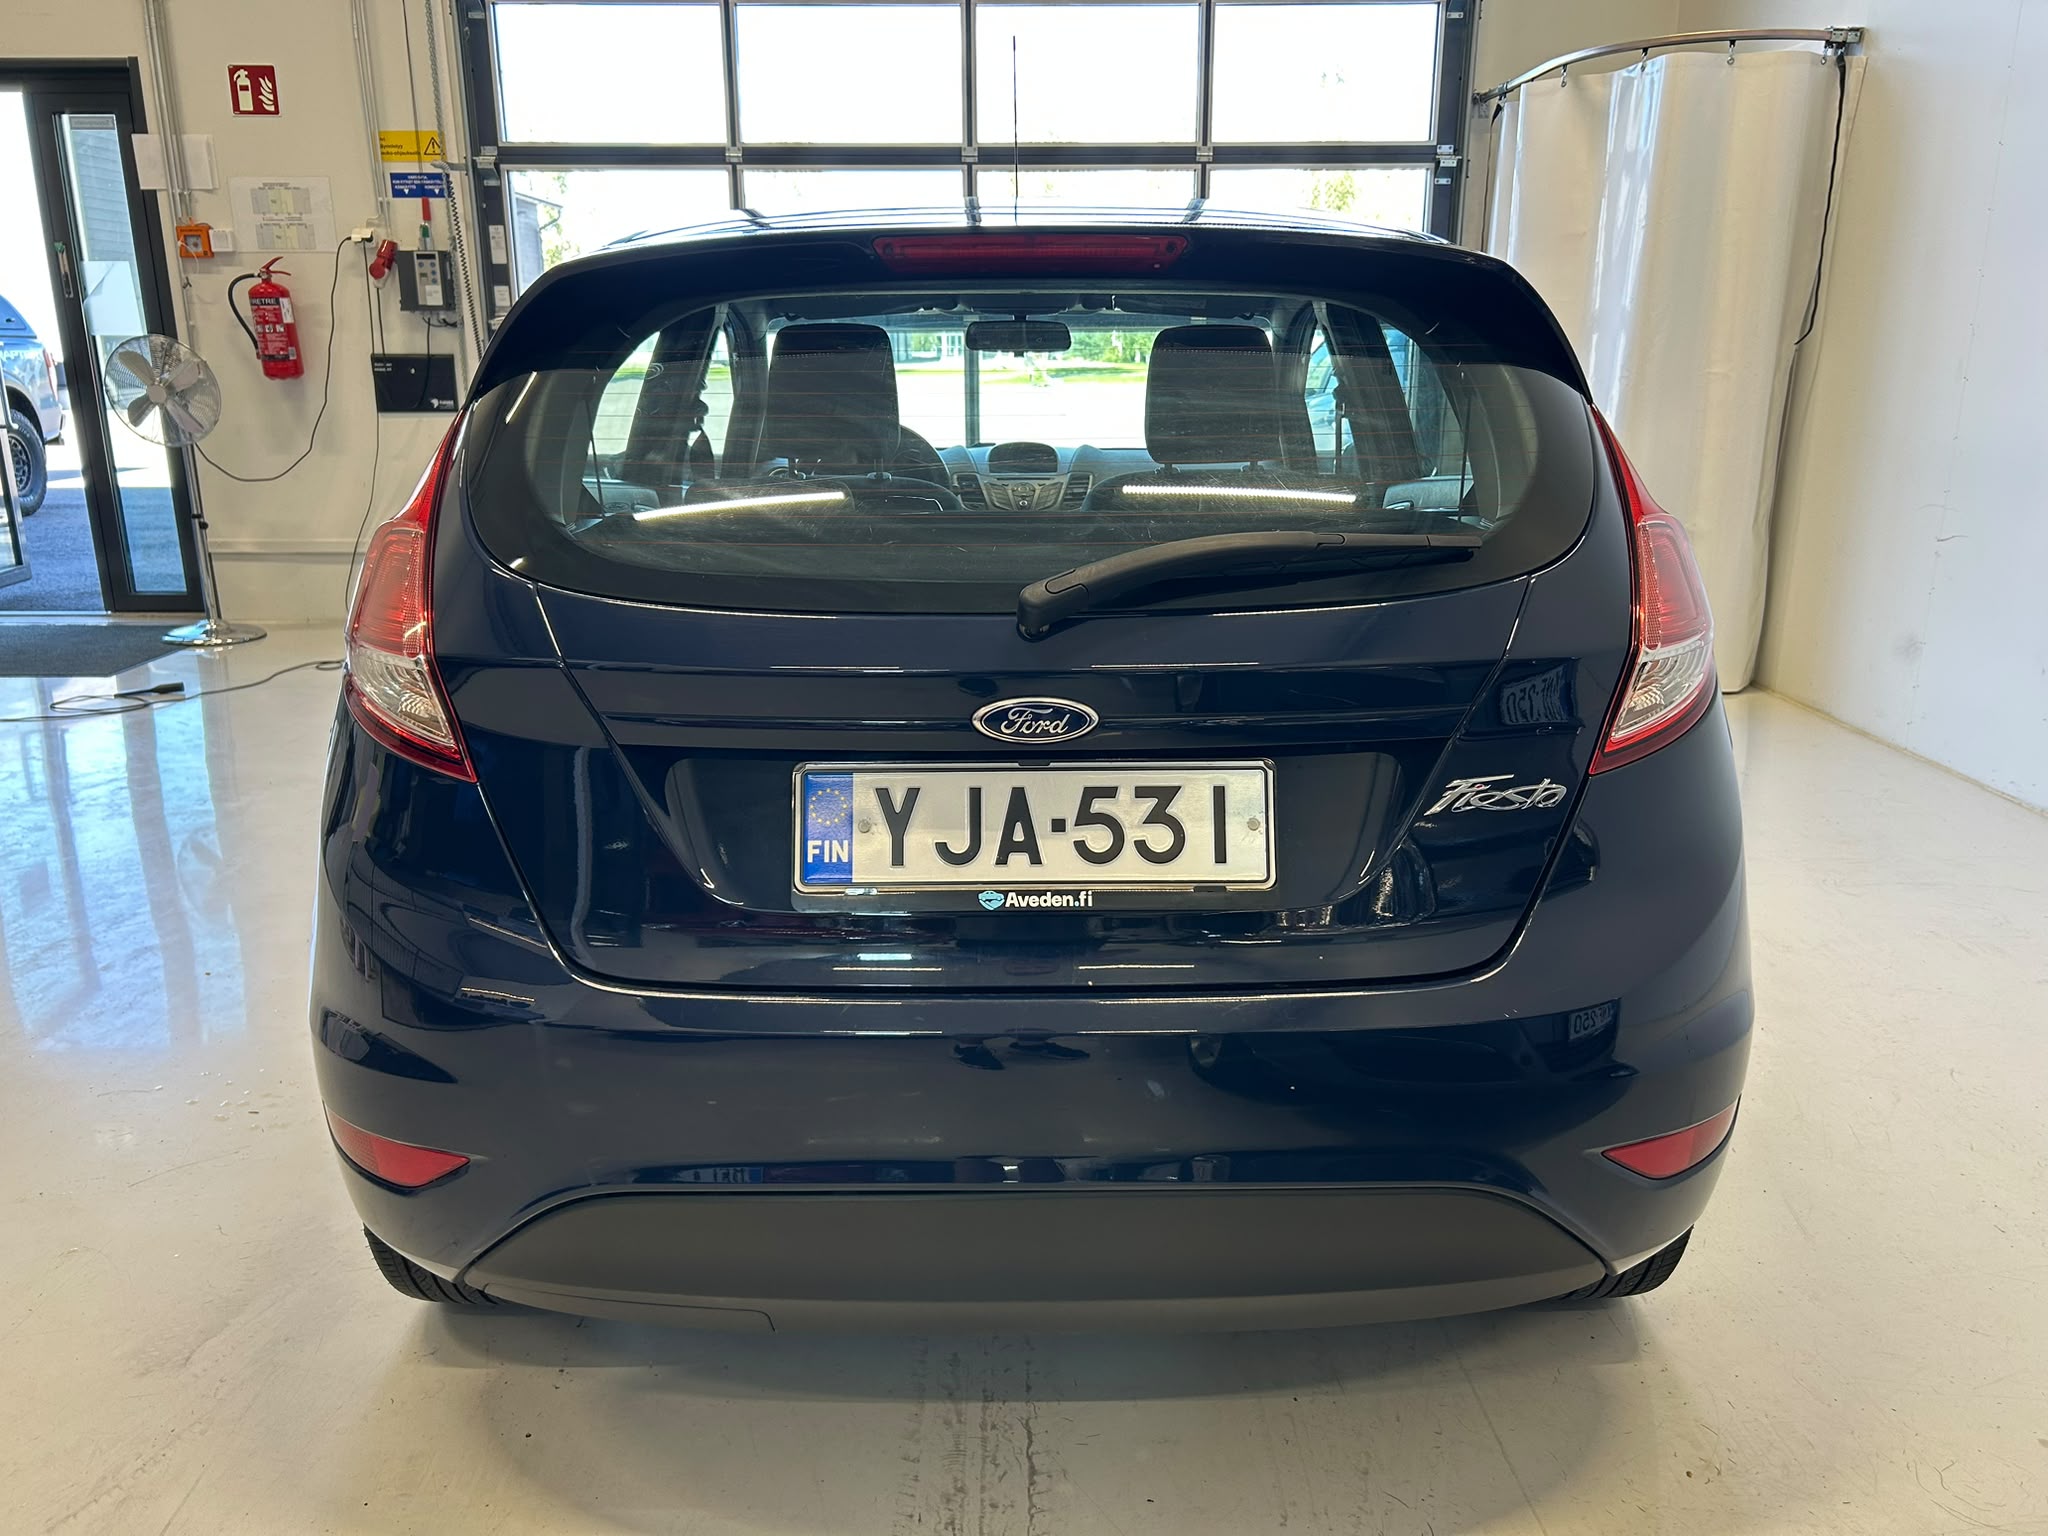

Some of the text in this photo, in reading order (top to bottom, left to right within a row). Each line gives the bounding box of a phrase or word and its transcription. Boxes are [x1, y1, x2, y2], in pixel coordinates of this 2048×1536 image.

[999, 706, 1069, 736] Ford
[1423, 774, 1568, 817] Fiesta
[806, 785, 1227, 867] FIN YJA-531
[1004, 890, 1094, 910] Aveden.fi
